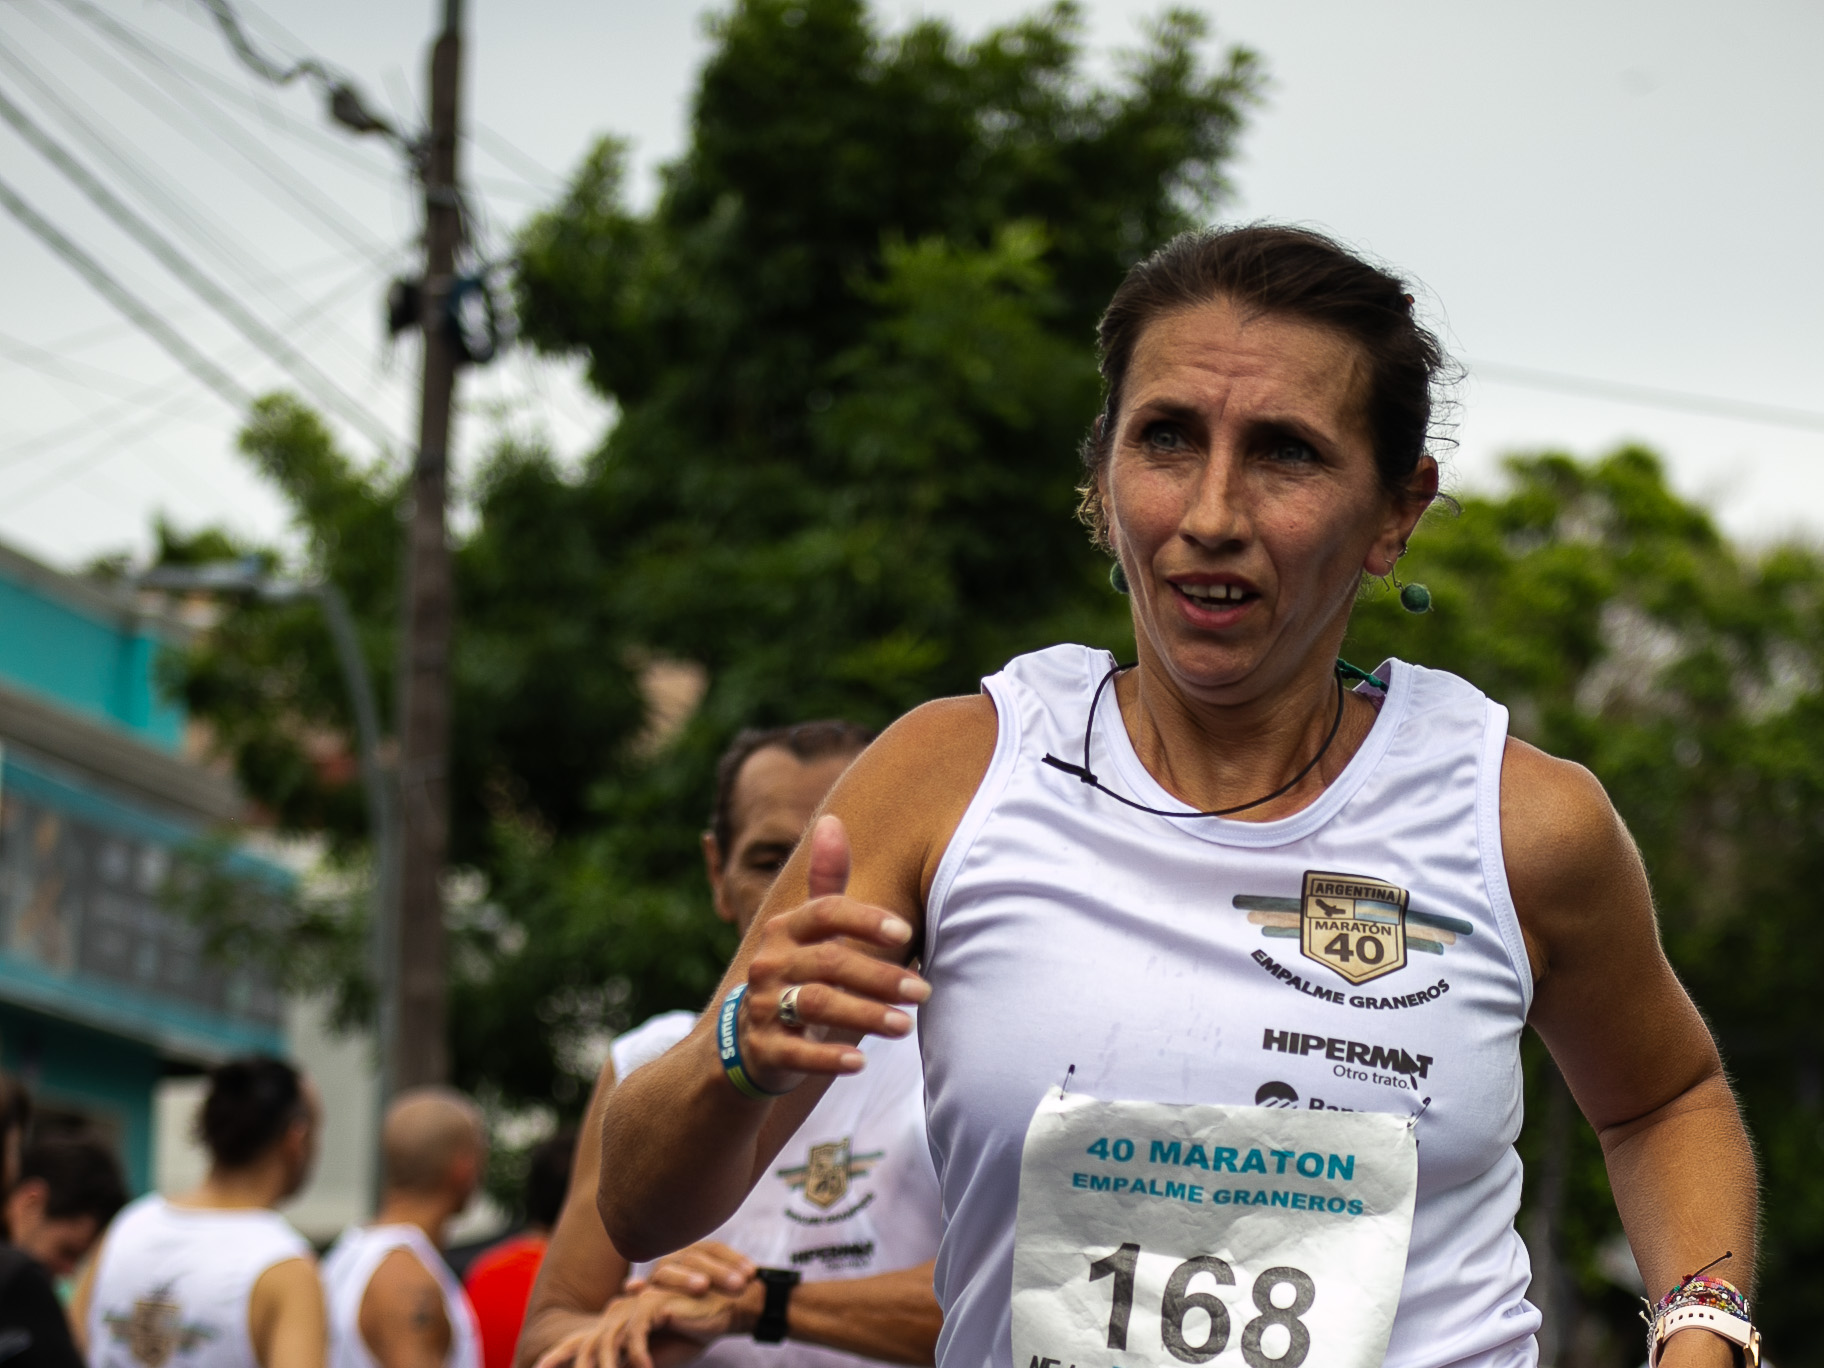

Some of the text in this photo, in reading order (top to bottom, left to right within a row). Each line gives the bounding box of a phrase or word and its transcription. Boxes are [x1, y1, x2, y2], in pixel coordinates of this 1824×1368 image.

[1315, 883, 1395, 902] ARGENTINA
[1315, 921, 1392, 936] MARATÓN
[1324, 933, 1384, 965] 40
[1251, 949, 1450, 1010] EMPALME GRANEROS
[1333, 1064, 1368, 1082] Otro
[1086, 1138, 1355, 1181] 40 MARATON
[1072, 1173, 1364, 1216] EMPALME GRANEROS
